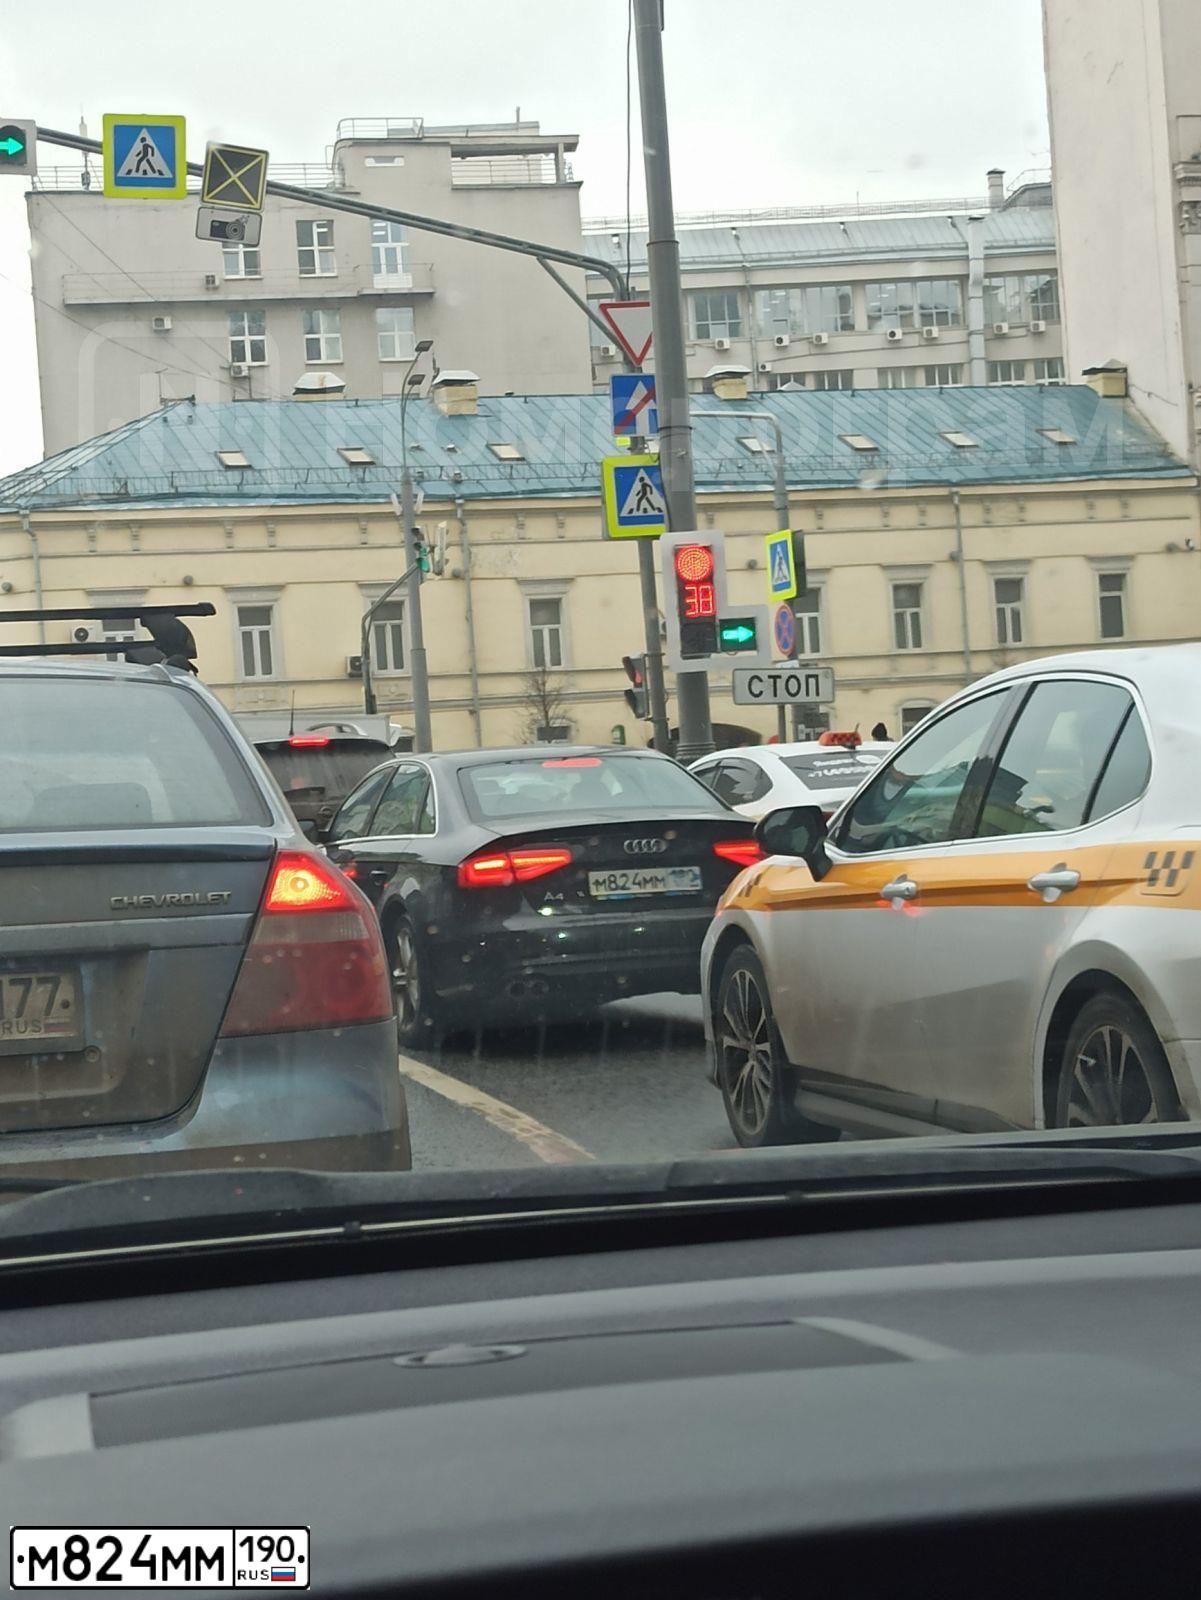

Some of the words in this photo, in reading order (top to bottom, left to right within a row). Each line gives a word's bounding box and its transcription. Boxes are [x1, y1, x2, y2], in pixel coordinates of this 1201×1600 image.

[685, 585, 714, 616] 38
[748, 674, 820, 698] СТОП
[110, 891, 232, 911] CHEVROLET
[544, 890, 564, 903] A4
[1, 1018, 43, 1035] RUS
